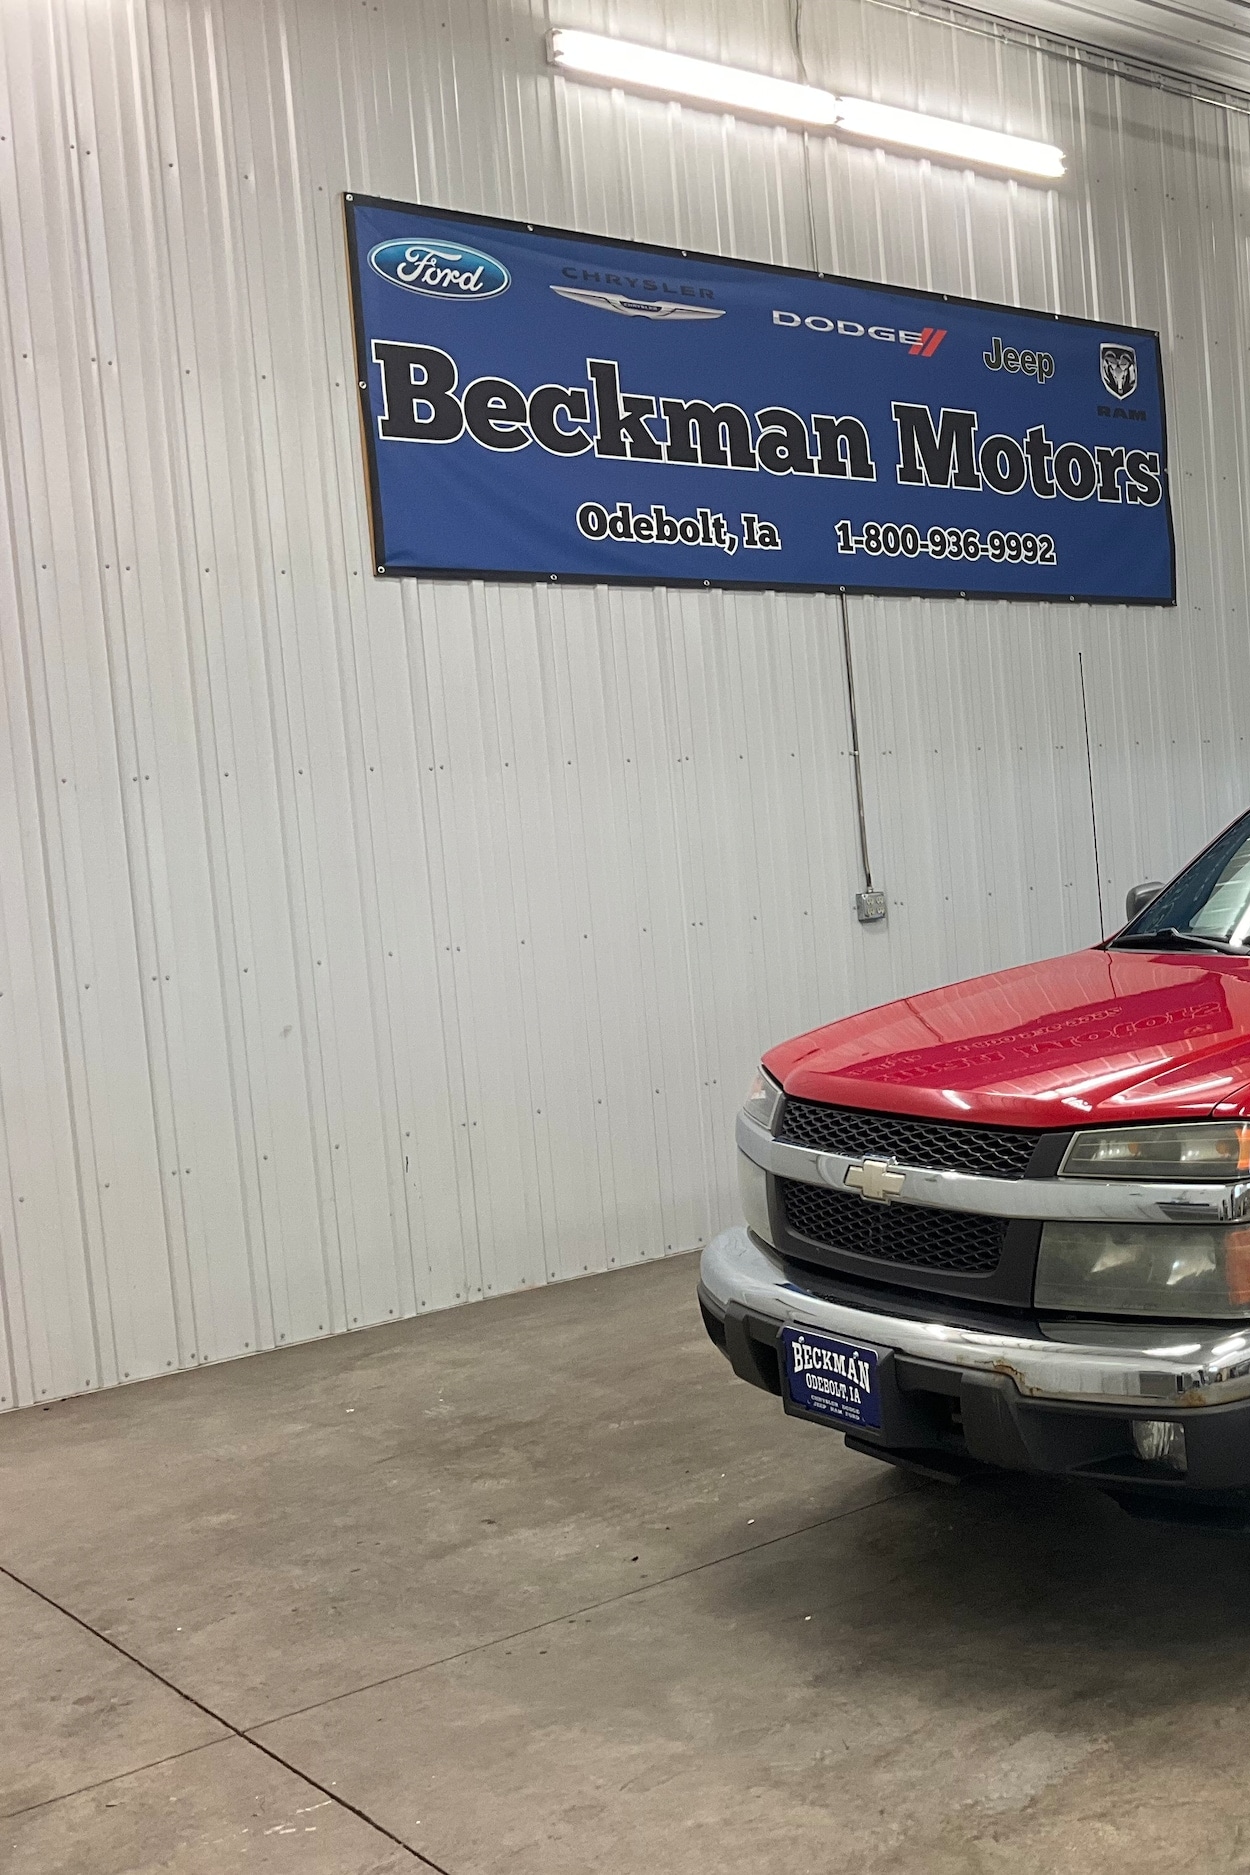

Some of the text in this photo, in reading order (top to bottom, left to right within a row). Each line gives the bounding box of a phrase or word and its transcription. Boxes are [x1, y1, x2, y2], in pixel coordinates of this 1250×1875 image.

[396, 247, 485, 293] Ford
[561, 266, 715, 300] CHRYSLER
[772, 310, 924, 346] DODGE
[983, 337, 1055, 384] Jeep
[371, 339, 1162, 506] Beckman Motors
[1097, 405, 1147, 422] RAM
[576, 502, 781, 555] Odebolt, Ia
[835, 520, 1057, 566] 1-800-936-9992
[791, 1341, 871, 1394] BECKMAN
[805, 1373, 861, 1404] ODEBOLT, IA
